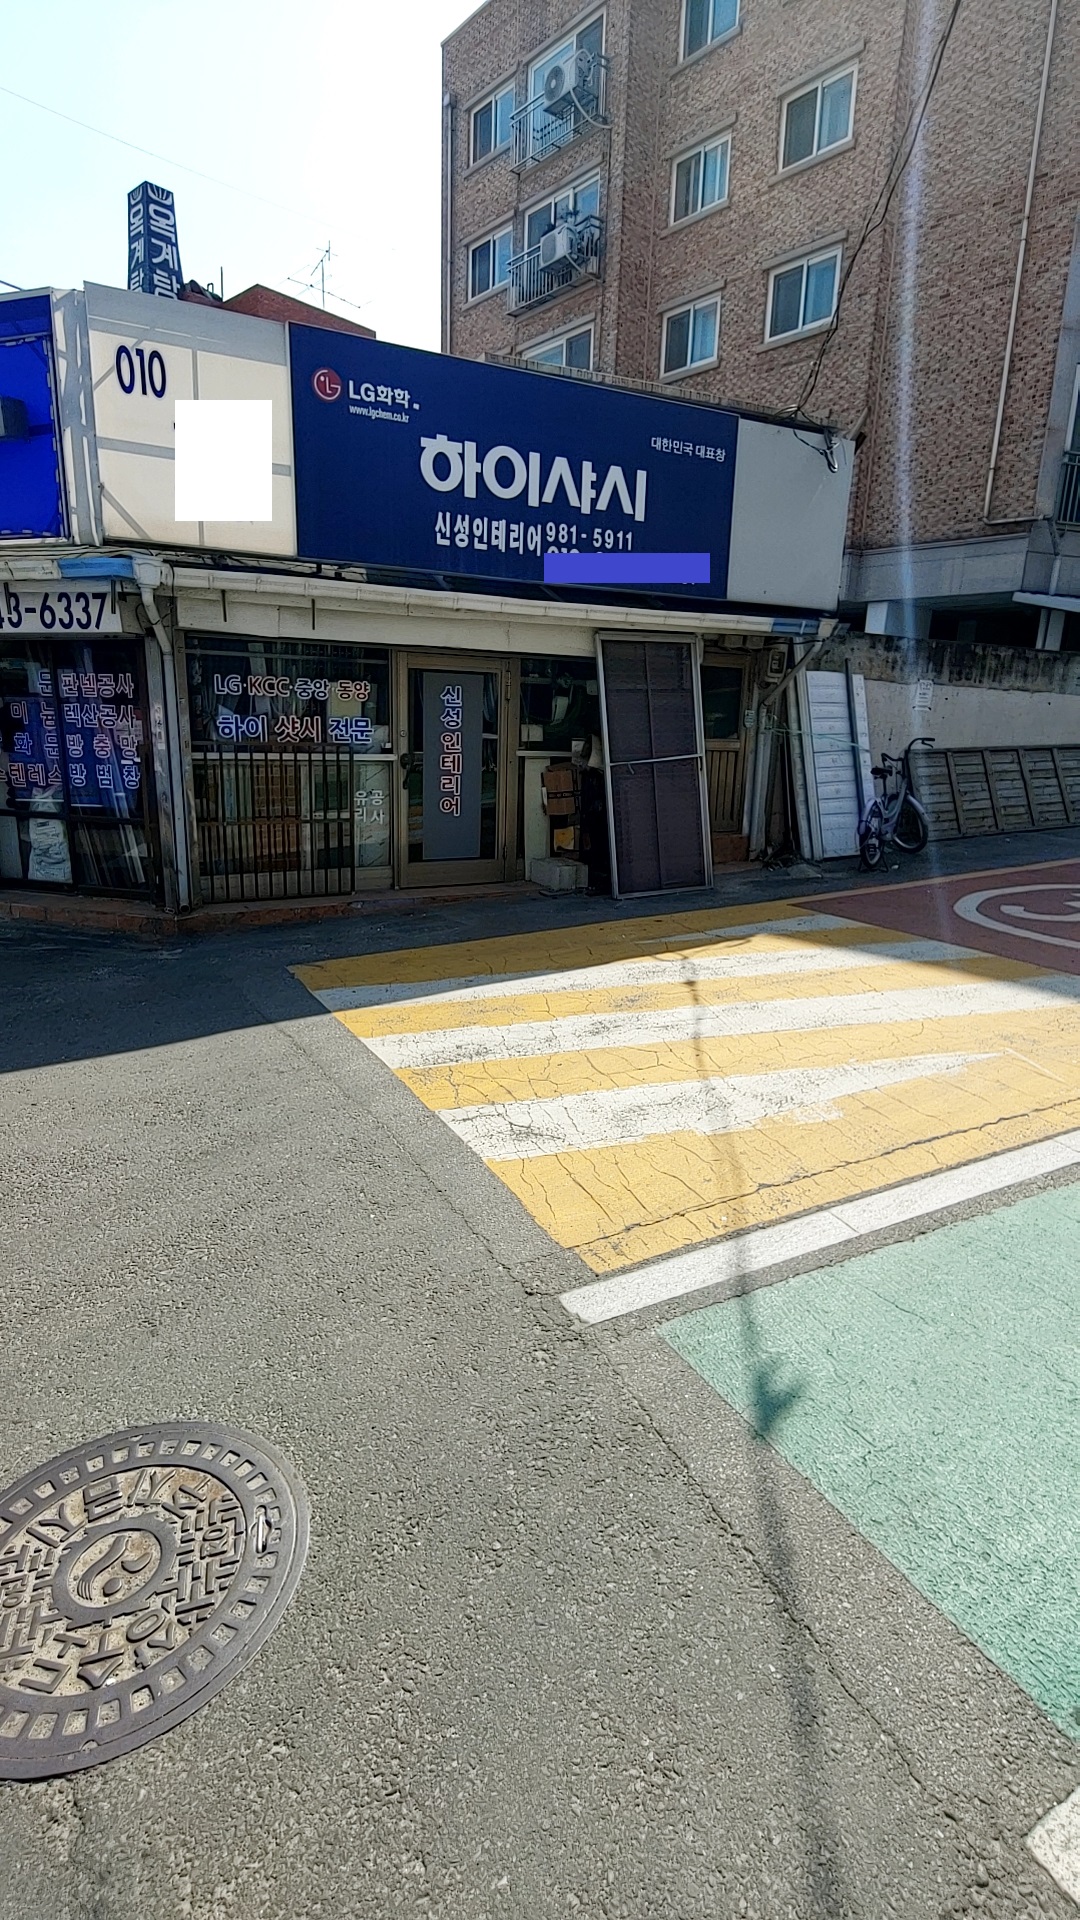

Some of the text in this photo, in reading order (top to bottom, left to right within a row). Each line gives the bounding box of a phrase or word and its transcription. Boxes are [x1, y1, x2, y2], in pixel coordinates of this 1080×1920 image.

[116, 344, 167, 398] 010
[348, 404, 410, 424] www.lgchem.co.kr
[650, 436, 727, 463] 대한민국 대표창
[419, 433, 648, 522] 하이샤시
[434, 511, 542, 556] 신성인테리어
[0, 591, 107, 630] 3-6337
[61, 672, 135, 699] 판넬공사
[63, 703, 136, 729] 렉산공사
[217, 714, 374, 744] 하이 샷시 전문
[439, 685, 463, 817] 신성인테리어
